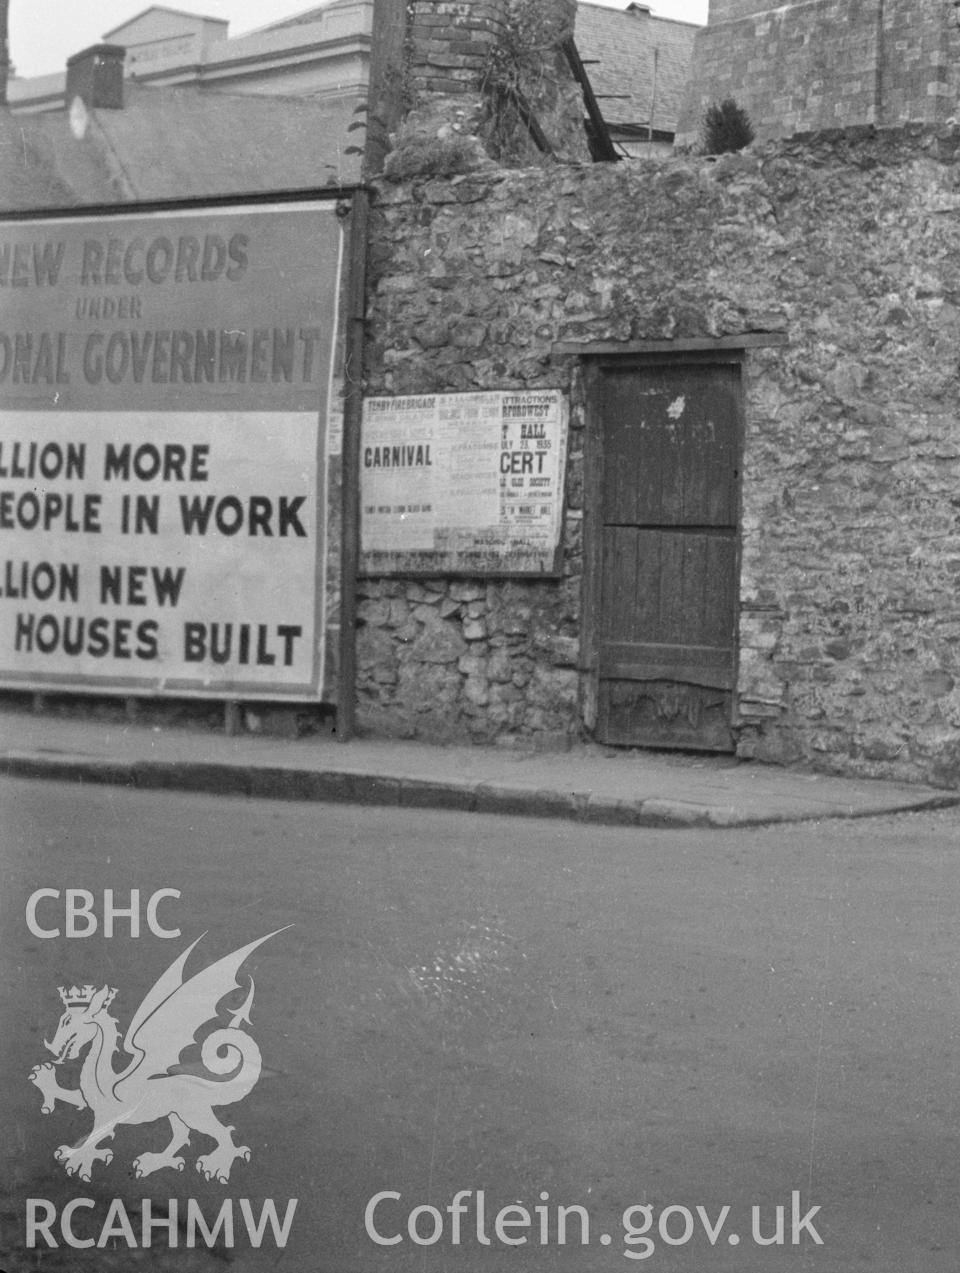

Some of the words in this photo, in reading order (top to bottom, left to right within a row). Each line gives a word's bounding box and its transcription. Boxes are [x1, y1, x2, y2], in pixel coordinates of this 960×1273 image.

[80, 234, 249, 286] RECORDS
[76, 296, 143, 320] UNDER
[83, 328, 322, 385] GOVERNMENT
[407, 396, 436, 409] BRIGADE
[520, 423, 546, 439] HALL
[104, 443, 210, 482] MORE
[364, 444, 433, 468] CARNIVAL
[500, 450, 548, 475] CERT
[0, 491, 102, 533] EOPLE
[121, 494, 160, 534] IN
[179, 494, 307, 537] WORK
[0, 560, 79, 604] LION
[100, 566, 186, 607] NEW
[15, 613, 159, 660] HOUSES
[184, 621, 302, 666] BUILT
